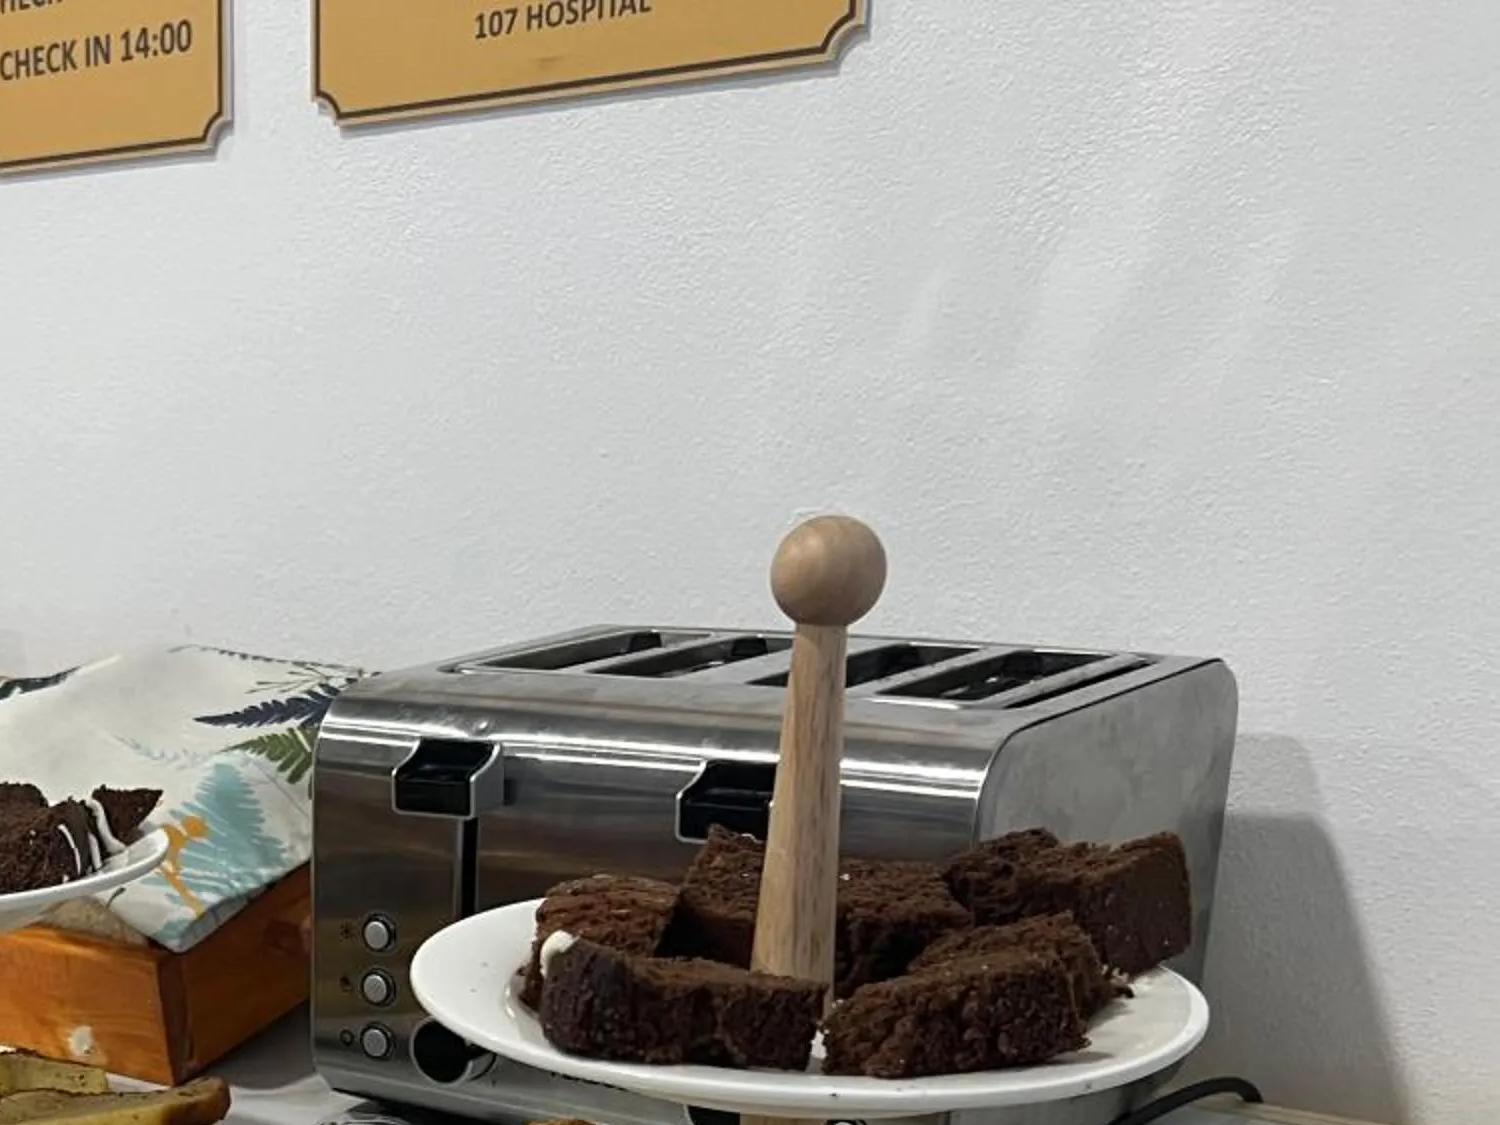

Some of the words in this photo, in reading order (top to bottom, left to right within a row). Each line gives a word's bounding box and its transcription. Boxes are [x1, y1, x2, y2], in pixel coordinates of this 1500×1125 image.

[474, 7, 518, 39] 107
[85, 33, 111, 68] IN
[121, 20, 192, 62] 14:00
